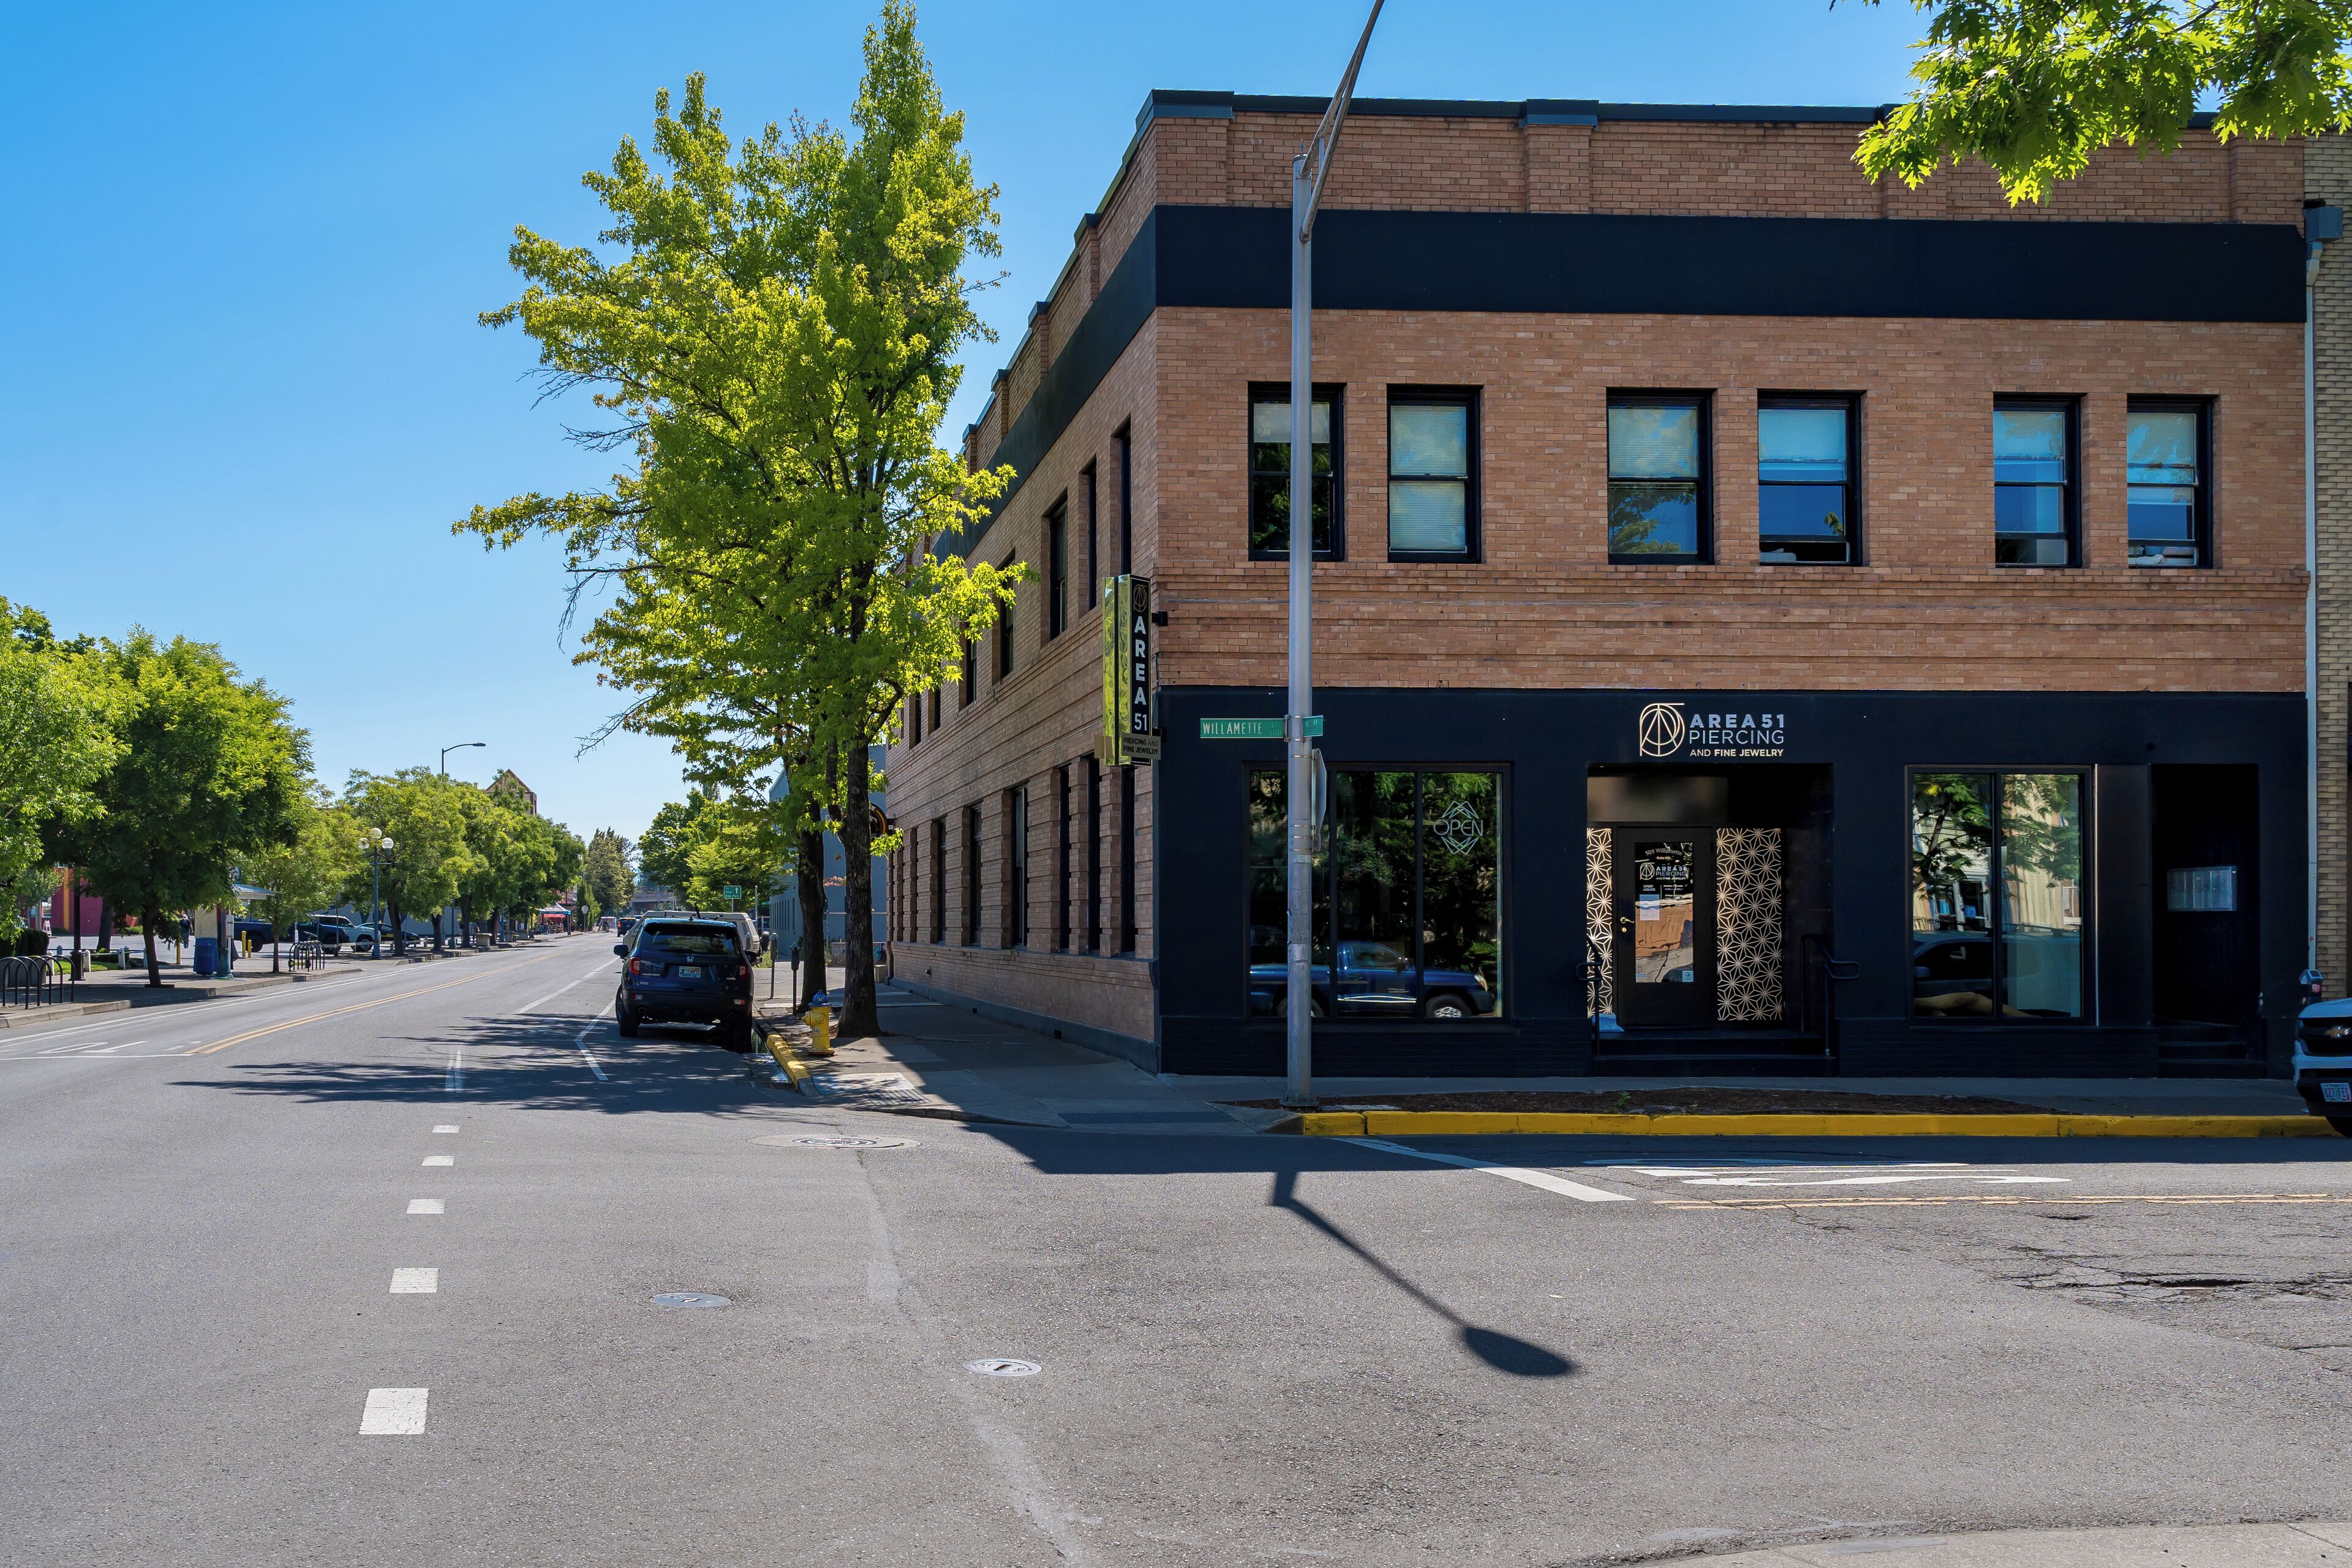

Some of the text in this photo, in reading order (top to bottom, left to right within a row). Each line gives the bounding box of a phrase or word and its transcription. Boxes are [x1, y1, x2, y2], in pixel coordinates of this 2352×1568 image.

[1134, 616, 1147, 731] AREA 51
[1689, 714, 1784, 728] AREA 51
[1202, 722, 1262, 735] WILLAMETTE
[1123, 737, 1147, 745] PIERCING
[1689, 730, 1784, 744] PIERCING
[1433, 819, 1483, 837] OPEN
